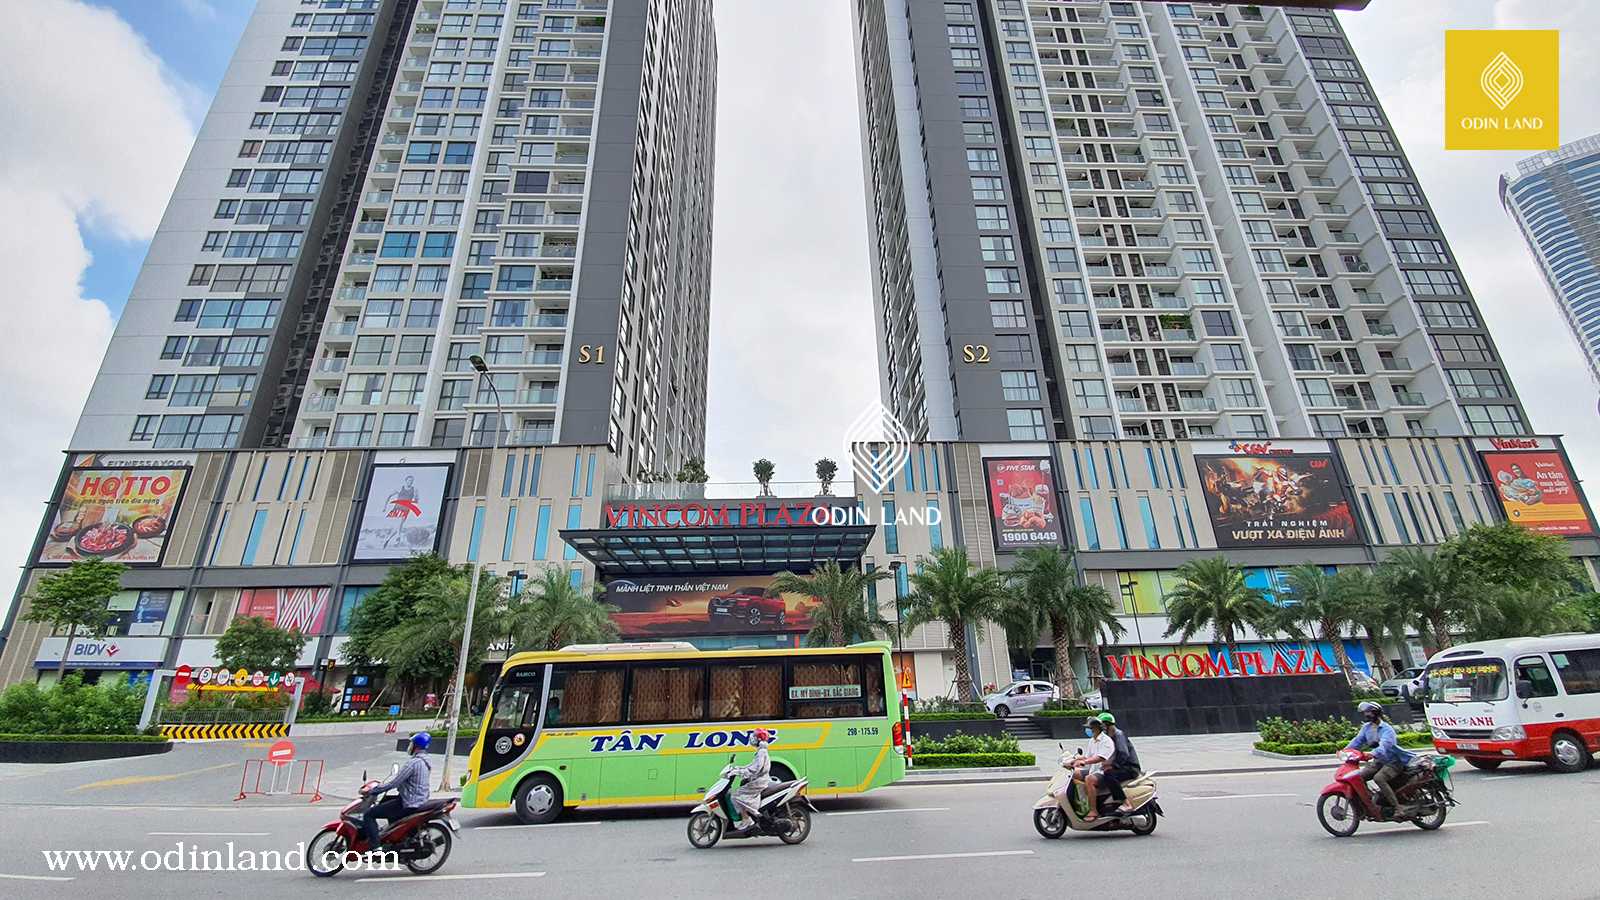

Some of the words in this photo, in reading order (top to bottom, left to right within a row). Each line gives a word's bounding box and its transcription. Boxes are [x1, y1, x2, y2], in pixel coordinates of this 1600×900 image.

[578, 344, 605, 364] S1
[963, 344, 991, 363] S2
[605, 502, 730, 528] VINCOM
[1002, 532, 1029, 541] 1900
[1030, 531, 1057, 541] 6449
[1267, 529, 1285, 539] XA
[1287, 527, 1315, 540] ĐIỆN
[695, 582, 710, 591] VIỆT
[74, 643, 107, 656] BIDV
[1105, 651, 1233, 680] VINCOM
[1235, 650, 1333, 676] PLAZA
[1469, 717, 1495, 726] ANH
[590, 730, 663, 753] TÂN
